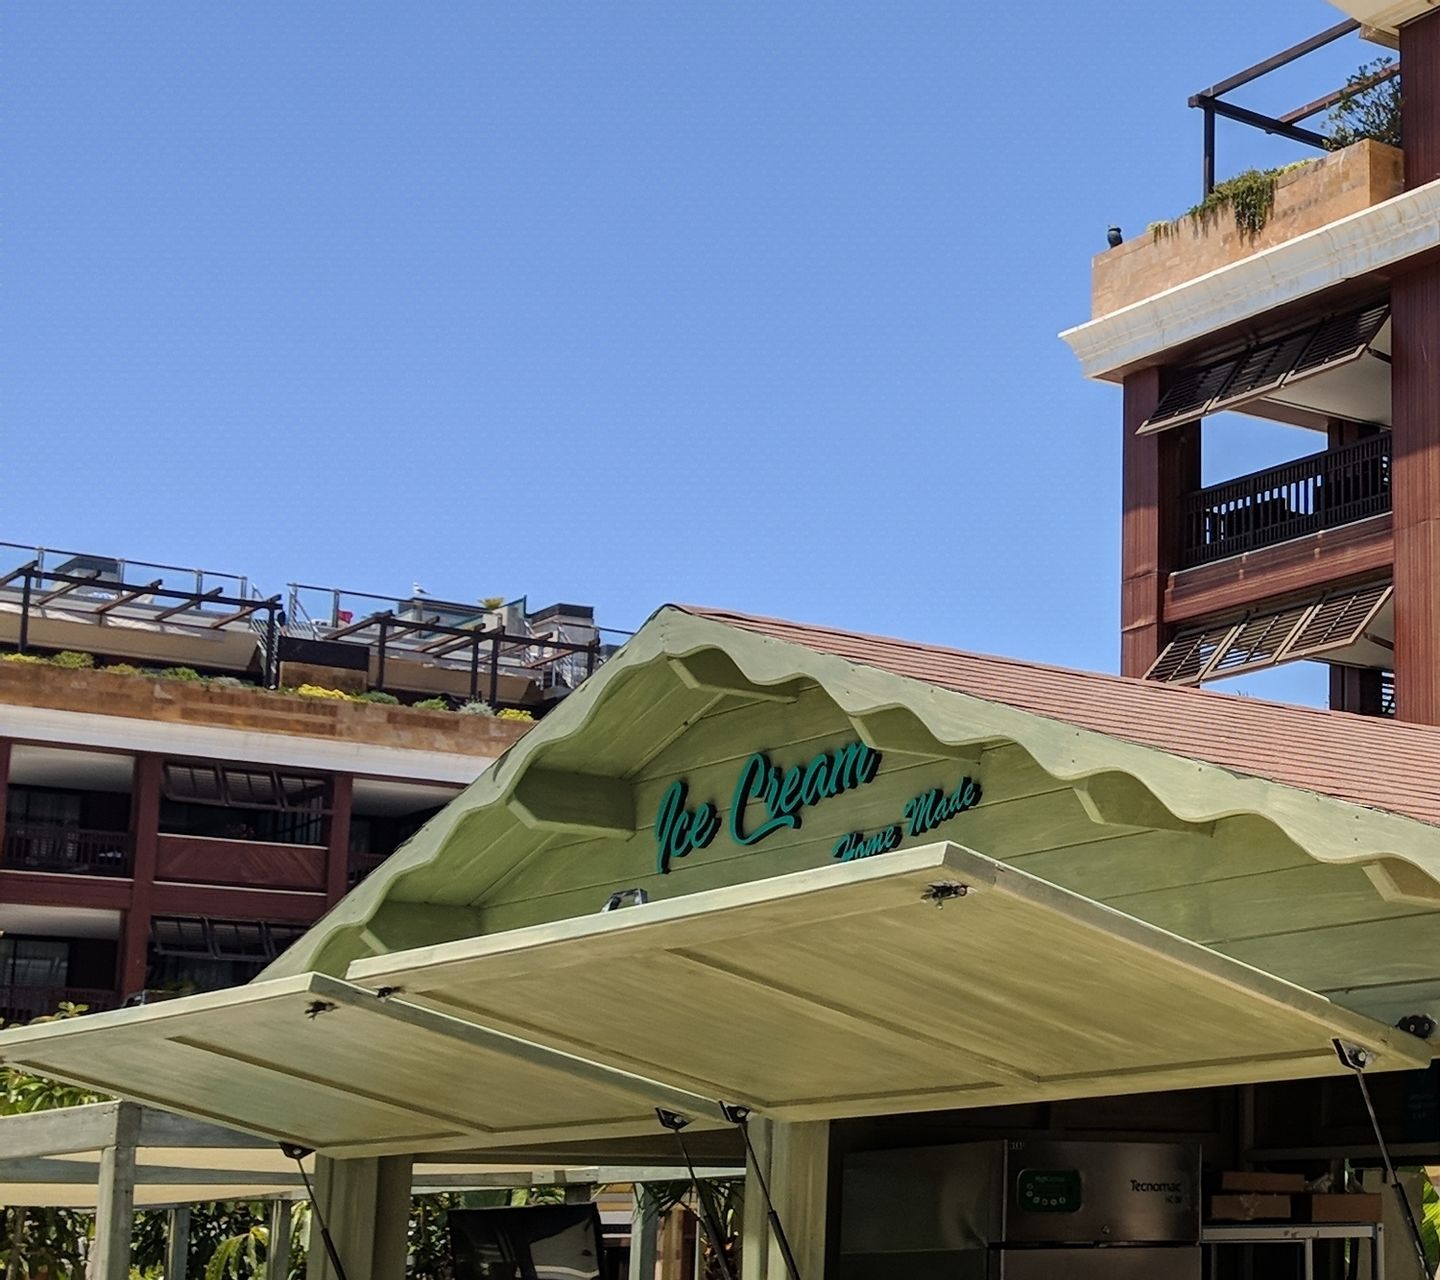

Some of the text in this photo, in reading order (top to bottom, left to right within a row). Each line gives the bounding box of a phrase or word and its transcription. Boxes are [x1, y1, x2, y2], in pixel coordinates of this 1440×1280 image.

[655, 740, 881, 874] Ice Cream
[832, 776, 982, 862] Home Made
